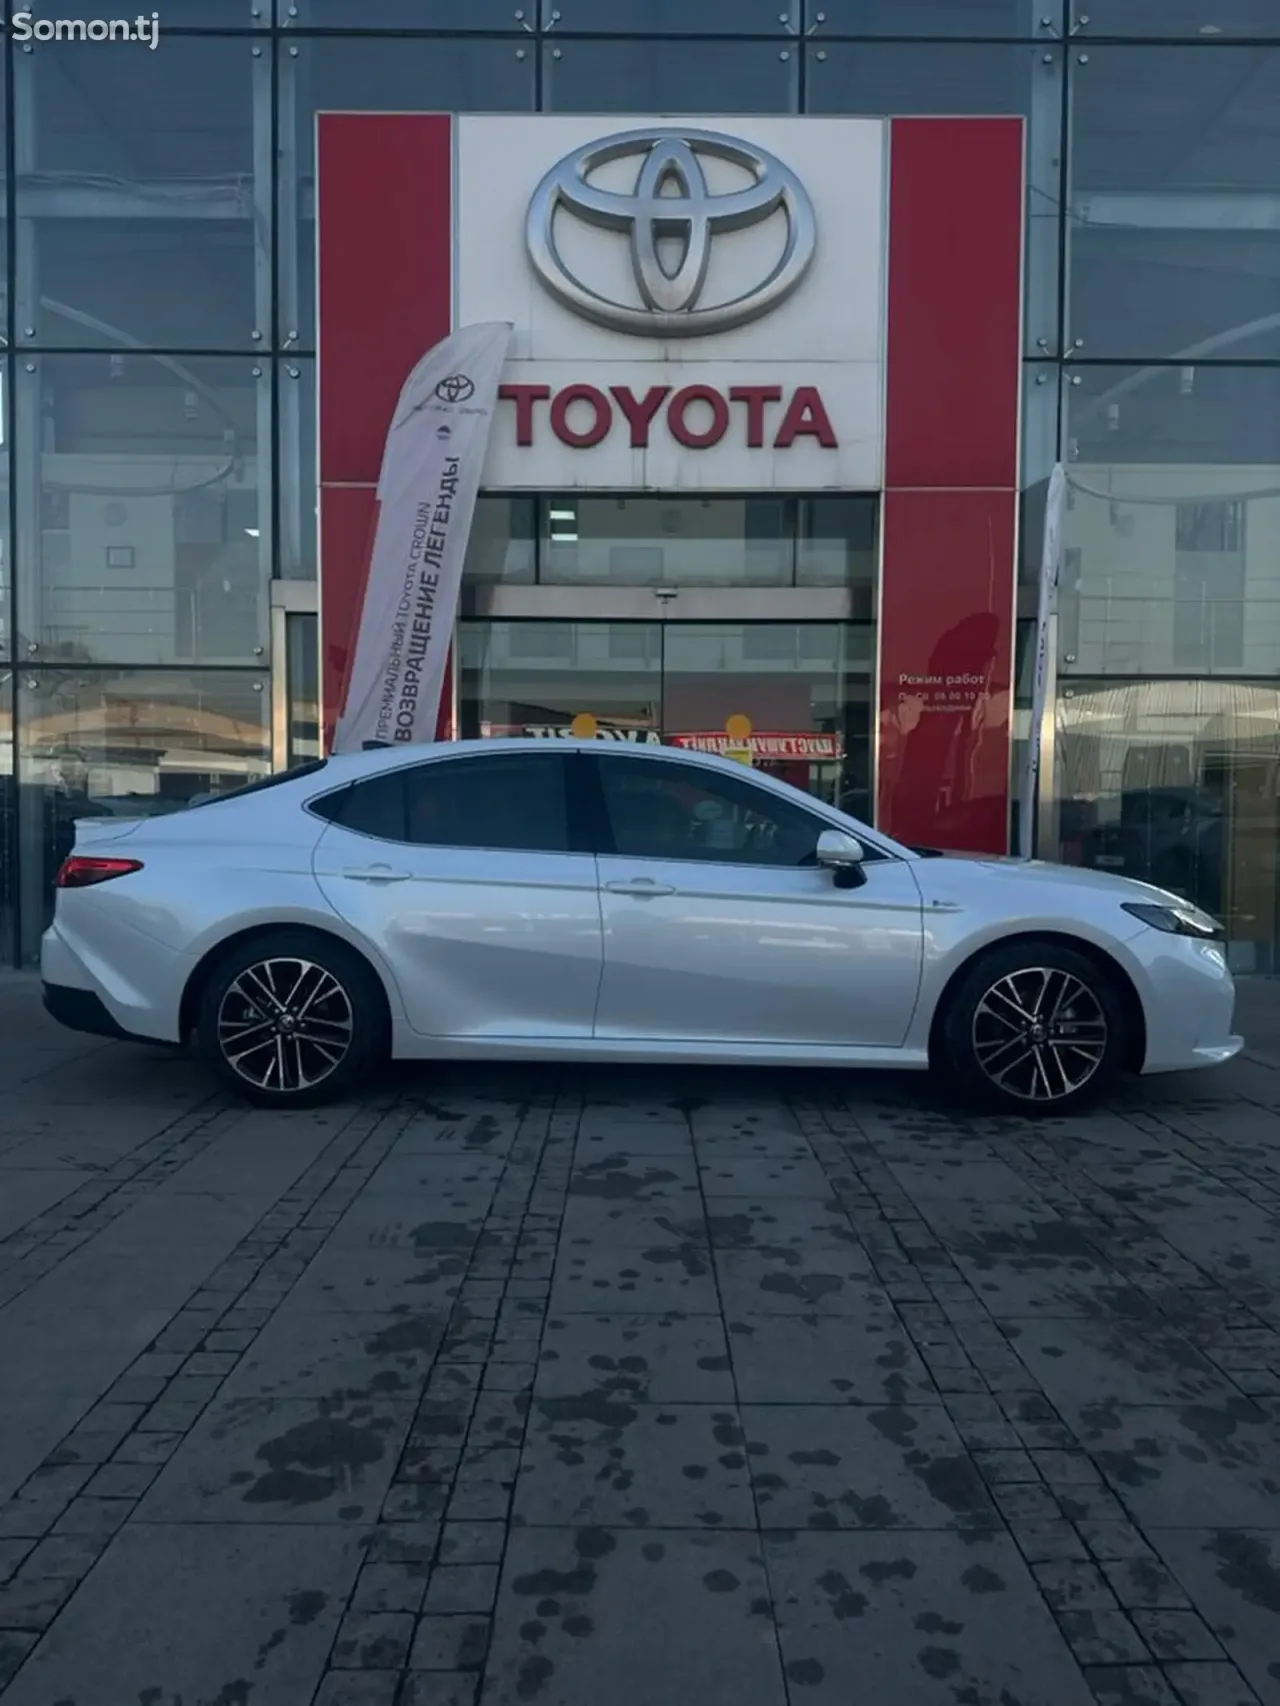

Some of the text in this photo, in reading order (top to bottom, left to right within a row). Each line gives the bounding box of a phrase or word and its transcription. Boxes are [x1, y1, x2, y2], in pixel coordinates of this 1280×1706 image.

[497, 383, 838, 450] TOYOTA
[394, 570, 440, 742] ВОЗВРАЩЕНИЕ
[424, 456, 460, 569] ЛЕГЕНДЫ
[395, 562, 417, 619] TOYOTA
[410, 501, 431, 560] CROWN
